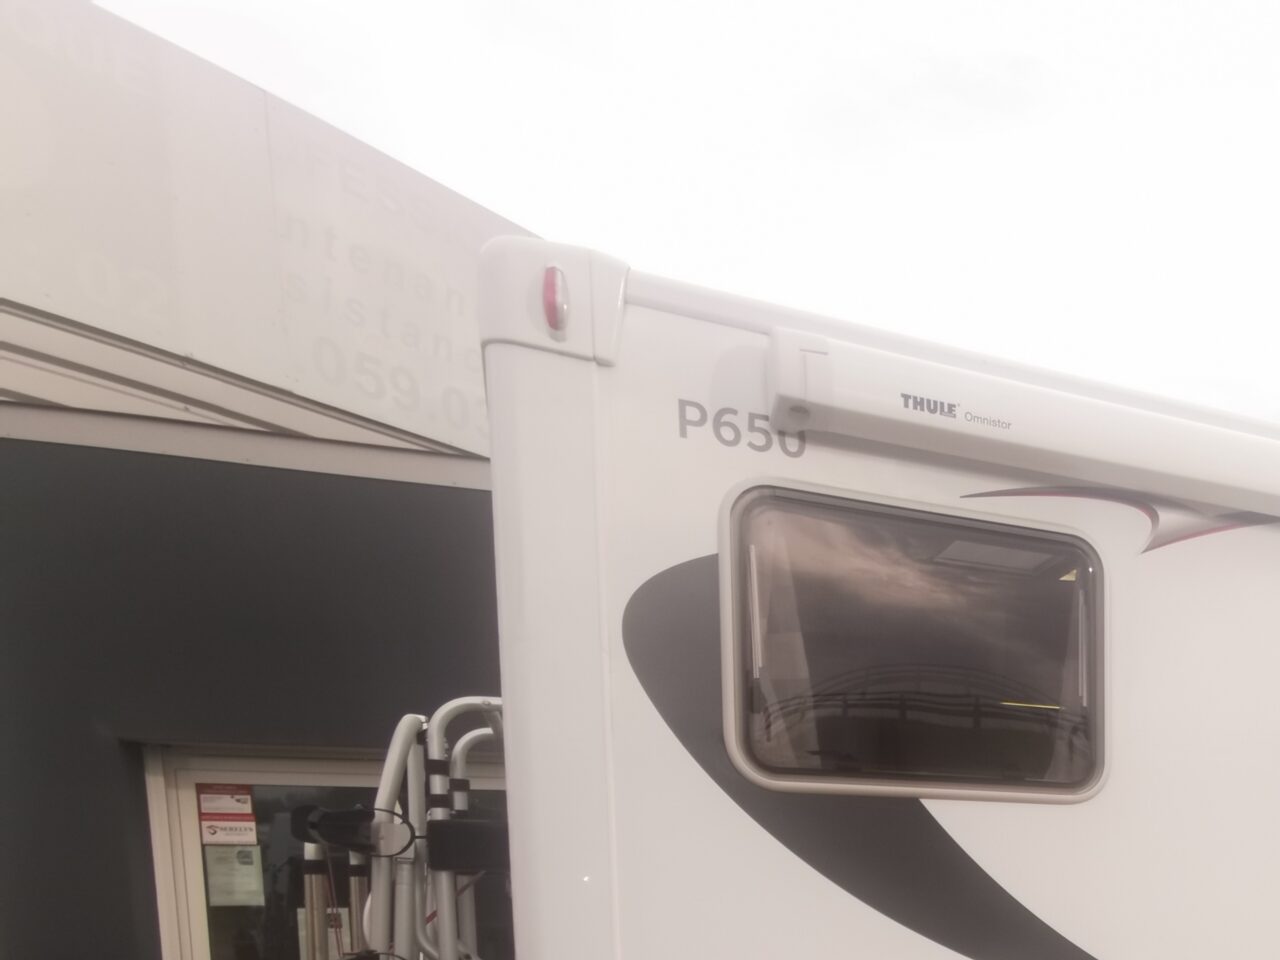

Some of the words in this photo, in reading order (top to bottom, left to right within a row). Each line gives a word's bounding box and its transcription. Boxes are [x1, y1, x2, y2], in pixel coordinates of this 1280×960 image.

[677, 398, 808, 458] P650
[900, 392, 958, 419] THULE
[963, 411, 1013, 430] Omnistor
